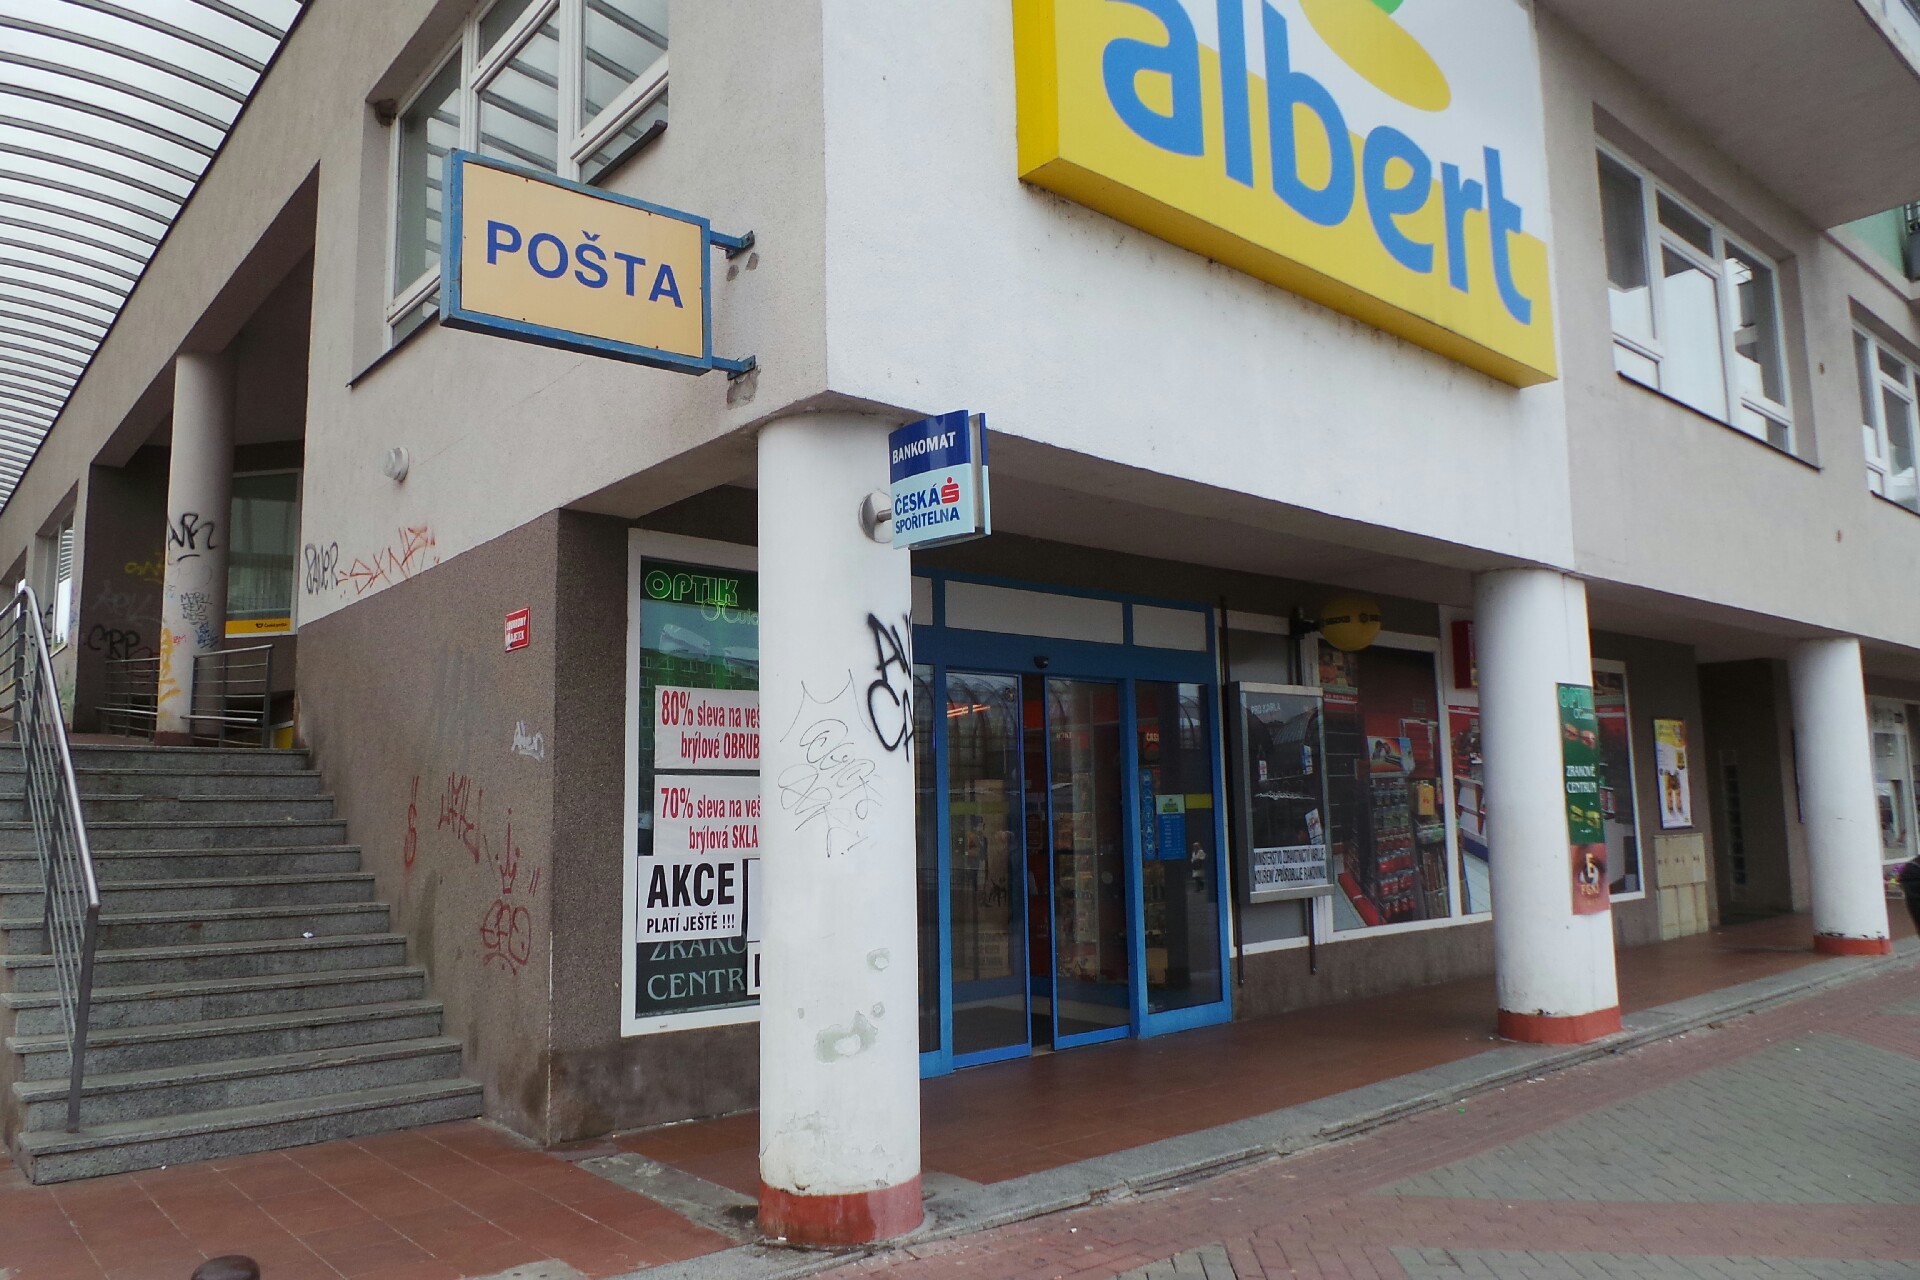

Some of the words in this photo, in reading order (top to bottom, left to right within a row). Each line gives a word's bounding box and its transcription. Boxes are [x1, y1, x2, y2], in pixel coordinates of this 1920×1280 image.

[1103, 0, 1532, 326] albert
[487, 219, 684, 309] POŠTA
[892, 431, 956, 465] BANKOMAT
[894, 483, 941, 516] ČESKÁ
[895, 506, 960, 535] SPOŘITELNA
[645, 569, 740, 607] OPTIK
[661, 690, 694, 726] 80%
[697, 700, 725, 727] sleva
[728, 707, 742, 728] na
[681, 731, 720, 765] brýlové
[660, 787, 694, 819] 70%
[697, 794, 726, 819] sleva
[728, 799, 742, 818] na
[689, 825, 729, 855] brýlová
[731, 824, 759, 849] SKLA
[646, 863, 735, 909] AKCE
[646, 912, 681, 934] PLATÍ
[683, 910, 718, 932] JEŠTĚ
[722, 913, 735, 929] !!!
[647, 967, 746, 1001] CENTR
